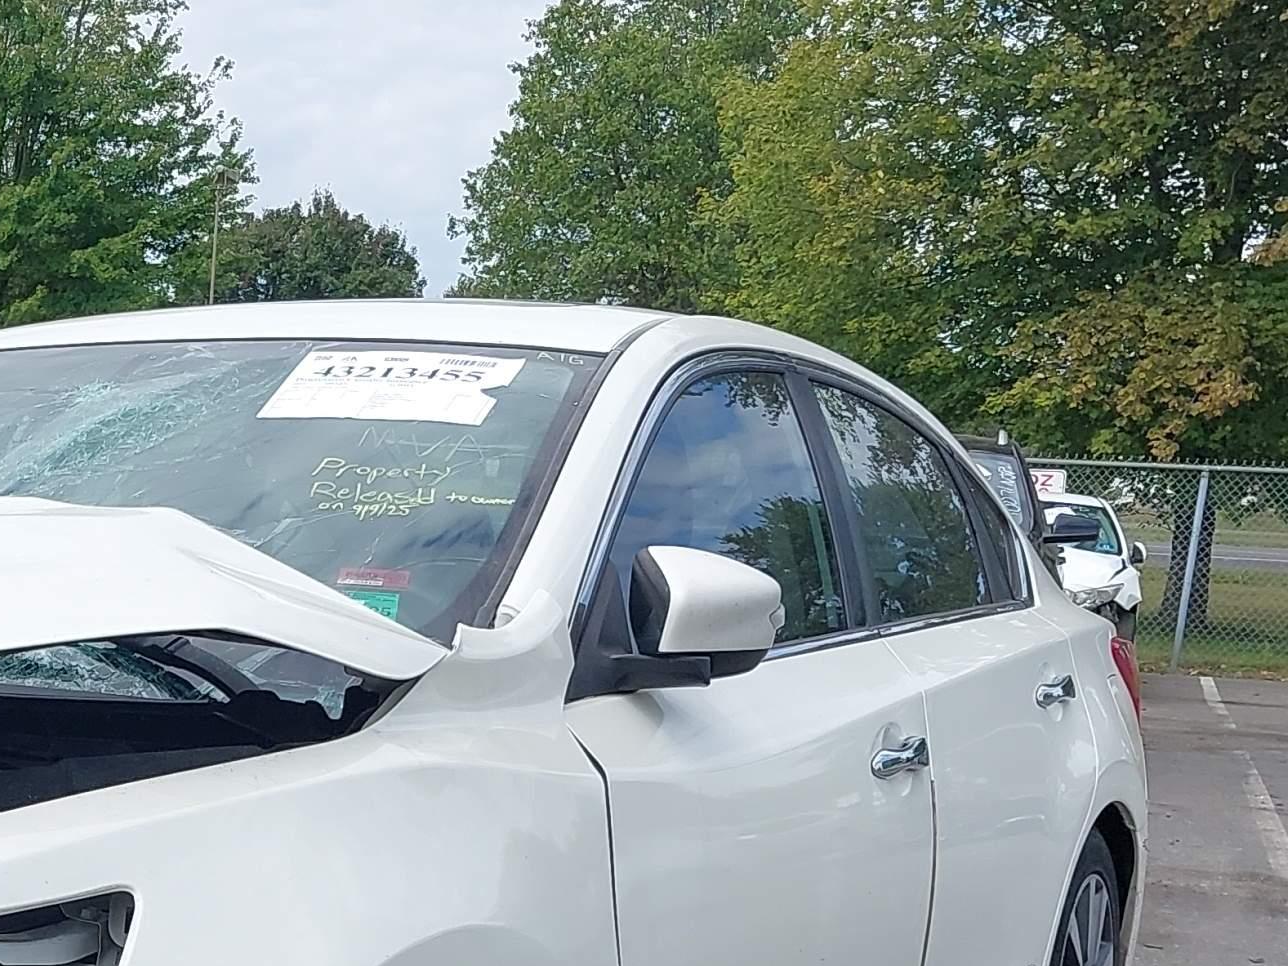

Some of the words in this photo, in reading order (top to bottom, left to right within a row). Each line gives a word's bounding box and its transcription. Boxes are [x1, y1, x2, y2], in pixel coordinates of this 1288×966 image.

[312, 365, 487, 383] 43213455
[310, 457, 451, 486] Property
[318, 501, 344, 510] on
